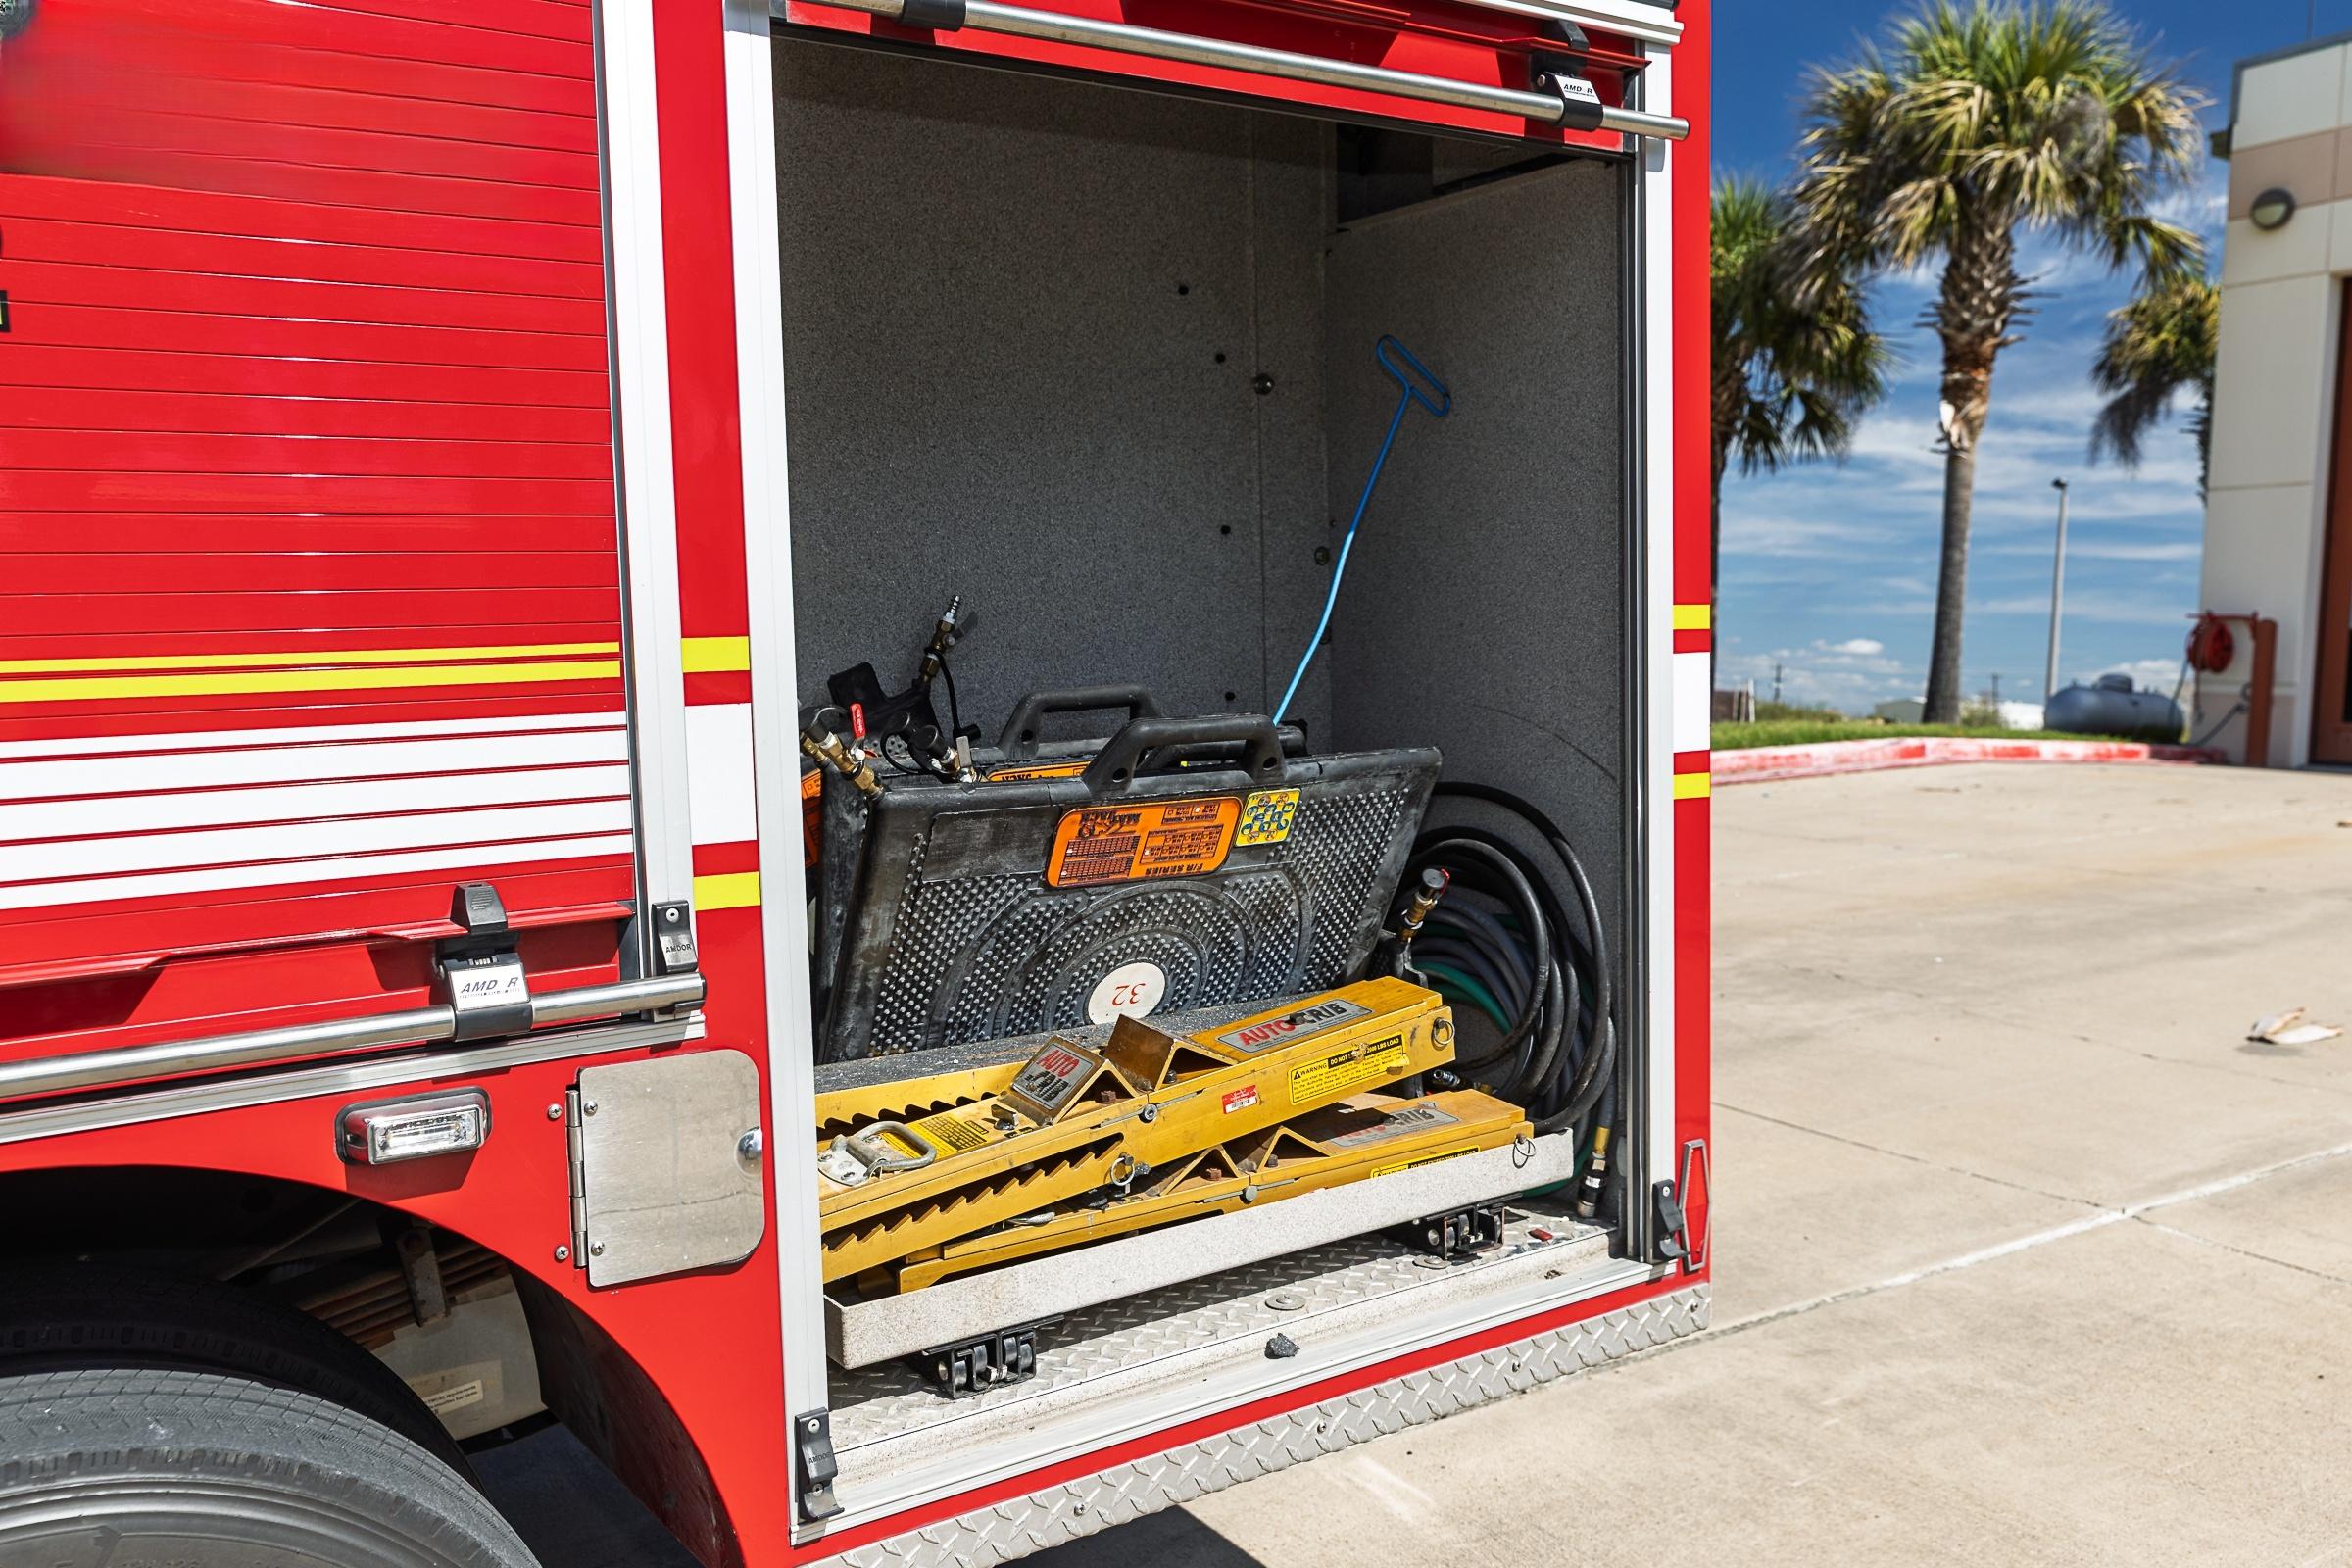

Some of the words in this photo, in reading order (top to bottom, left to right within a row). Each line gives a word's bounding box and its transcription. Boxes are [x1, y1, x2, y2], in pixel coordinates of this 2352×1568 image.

[1564, 84, 1592, 94] AMDR
[666, 943, 692, 953] AMDOR
[461, 977, 518, 993] AMDR
[1111, 983, 1146, 1006] 32
[1036, 1049, 1080, 1077] AUTO
[1300, 1062, 1327, 1076] WARNING
[1338, 1054, 1348, 1063] NOT
[1386, 1038, 1399, 1047] LOAD
